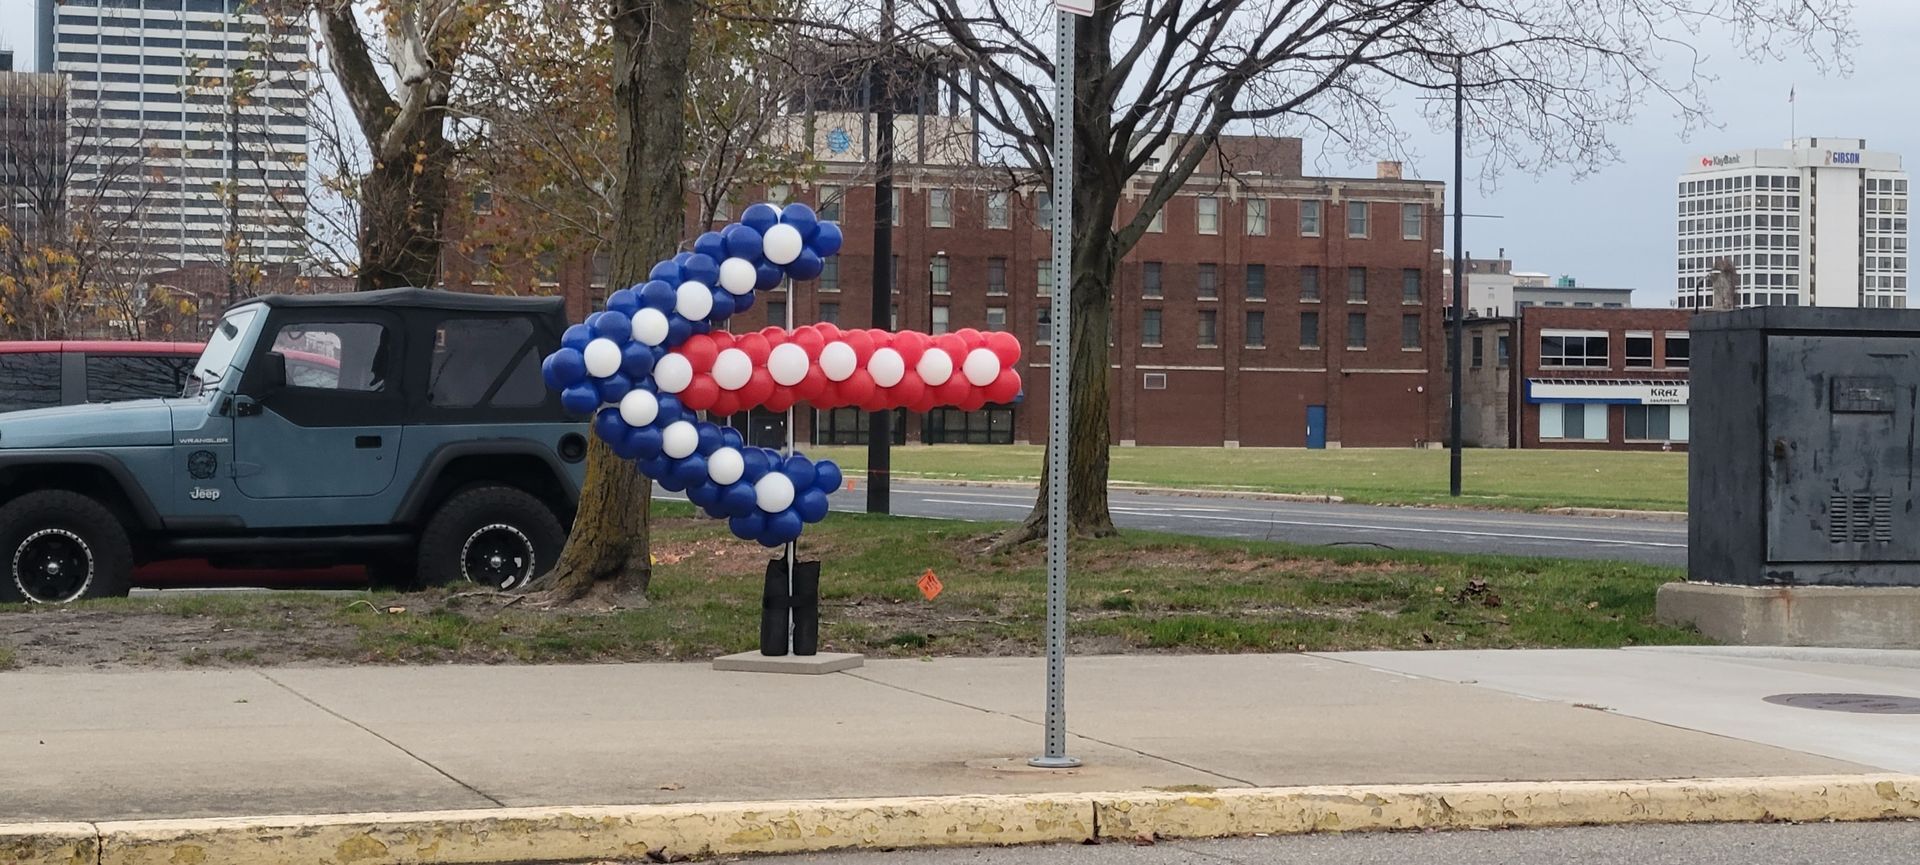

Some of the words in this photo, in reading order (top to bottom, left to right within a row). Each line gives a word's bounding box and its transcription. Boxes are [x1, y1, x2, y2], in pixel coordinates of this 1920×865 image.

[1832, 151, 1860, 164] GIBSON
[1650, 388, 1678, 398] KRAZ
[189, 486, 220, 500] Jeep
